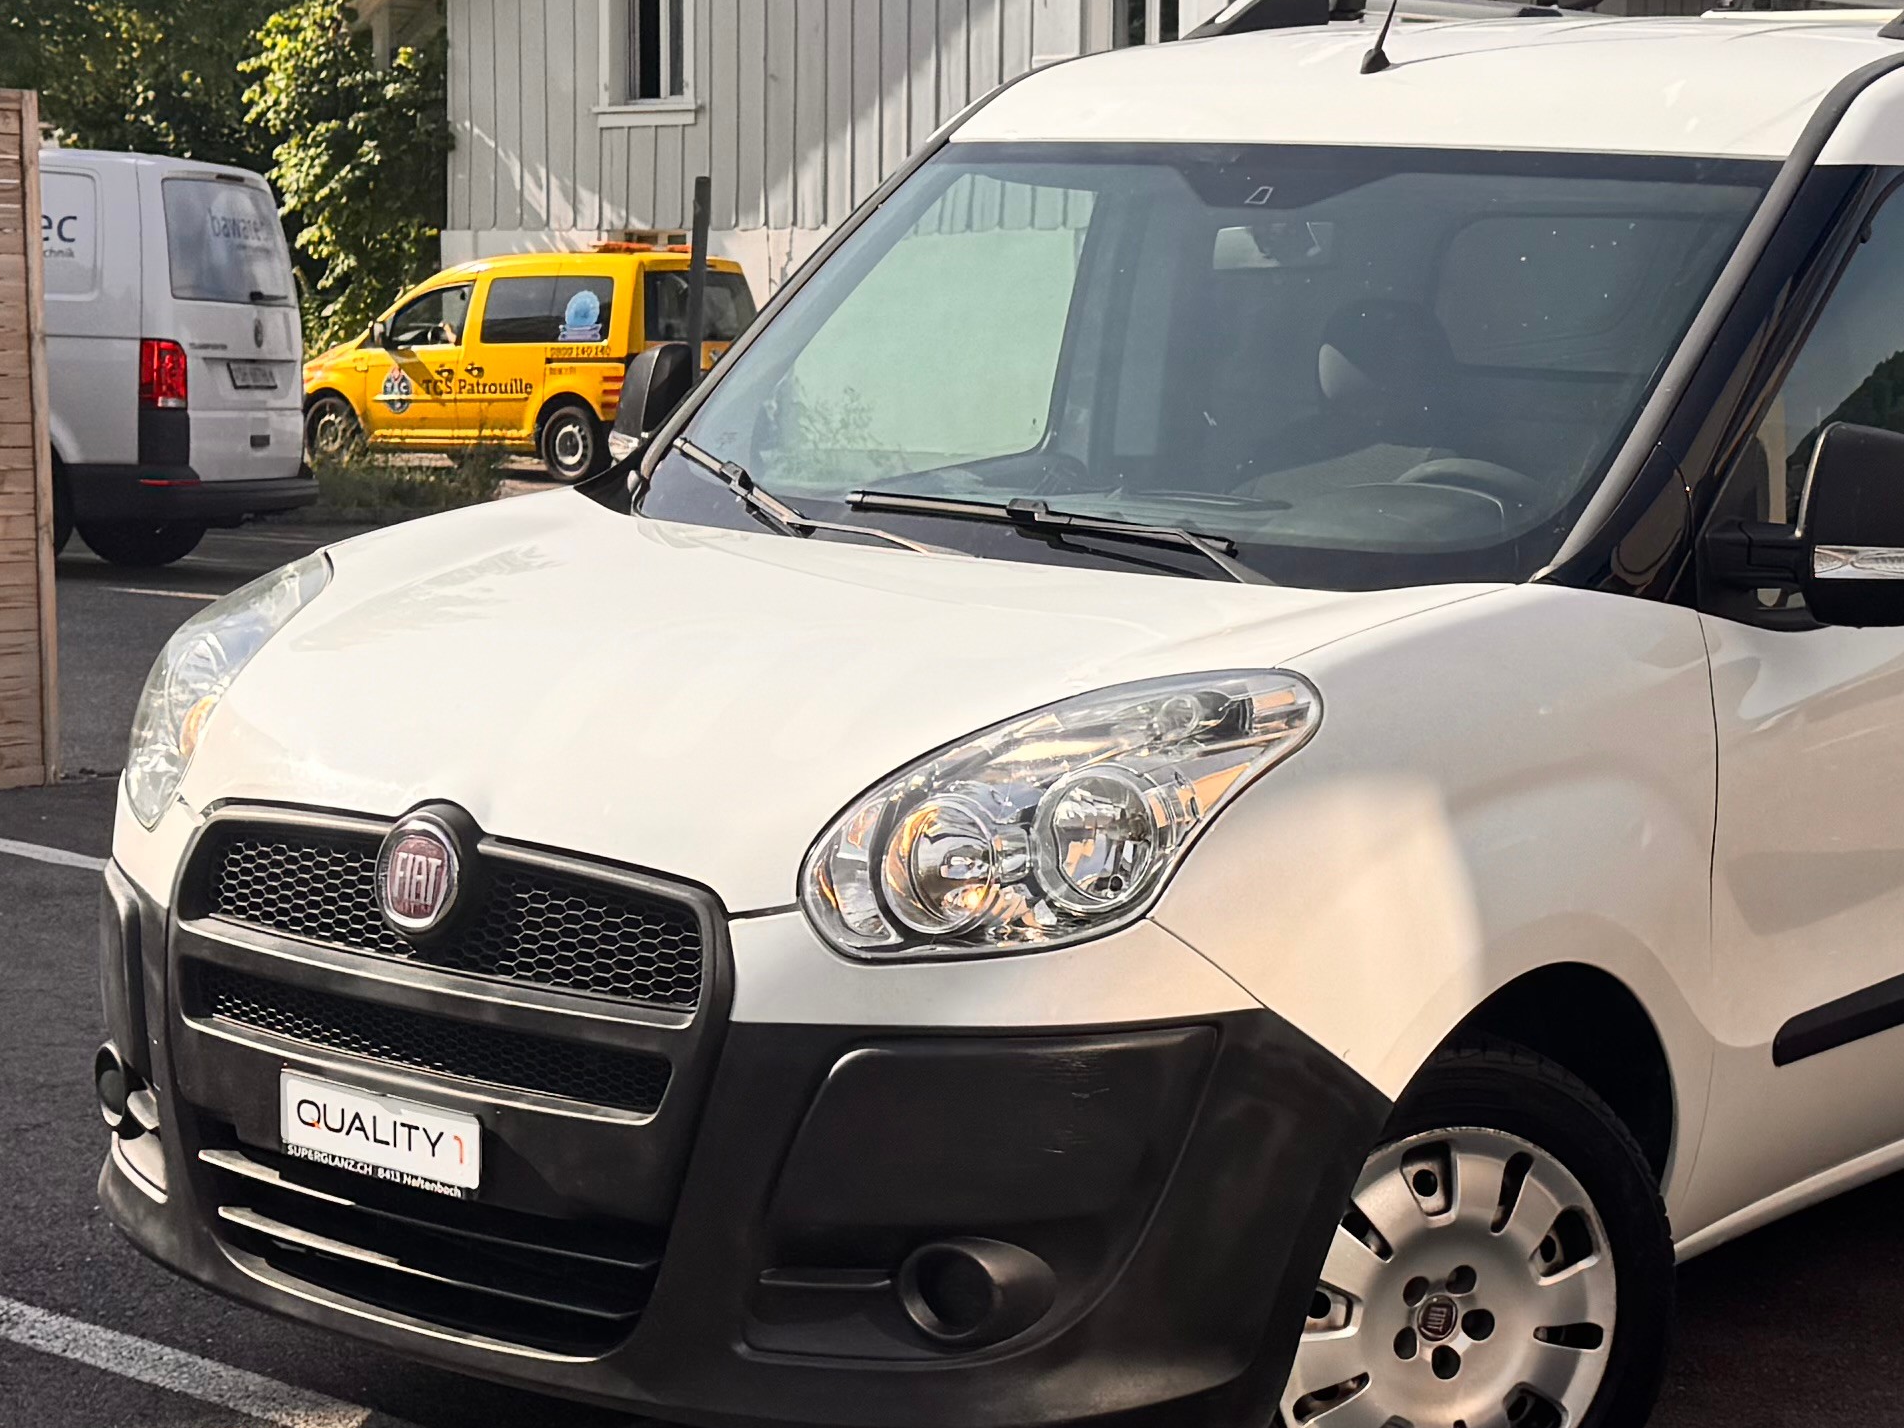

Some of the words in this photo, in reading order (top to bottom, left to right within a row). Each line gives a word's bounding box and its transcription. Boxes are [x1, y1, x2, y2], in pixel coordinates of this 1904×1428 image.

[423, 379, 452, 396] TCS
[458, 378, 533, 395] Patrouille
[393, 852, 442, 905] FIAT
[297, 1099, 444, 1158] QUALITY
[287, 1145, 373, 1176] SUPERGLANZ.CH
